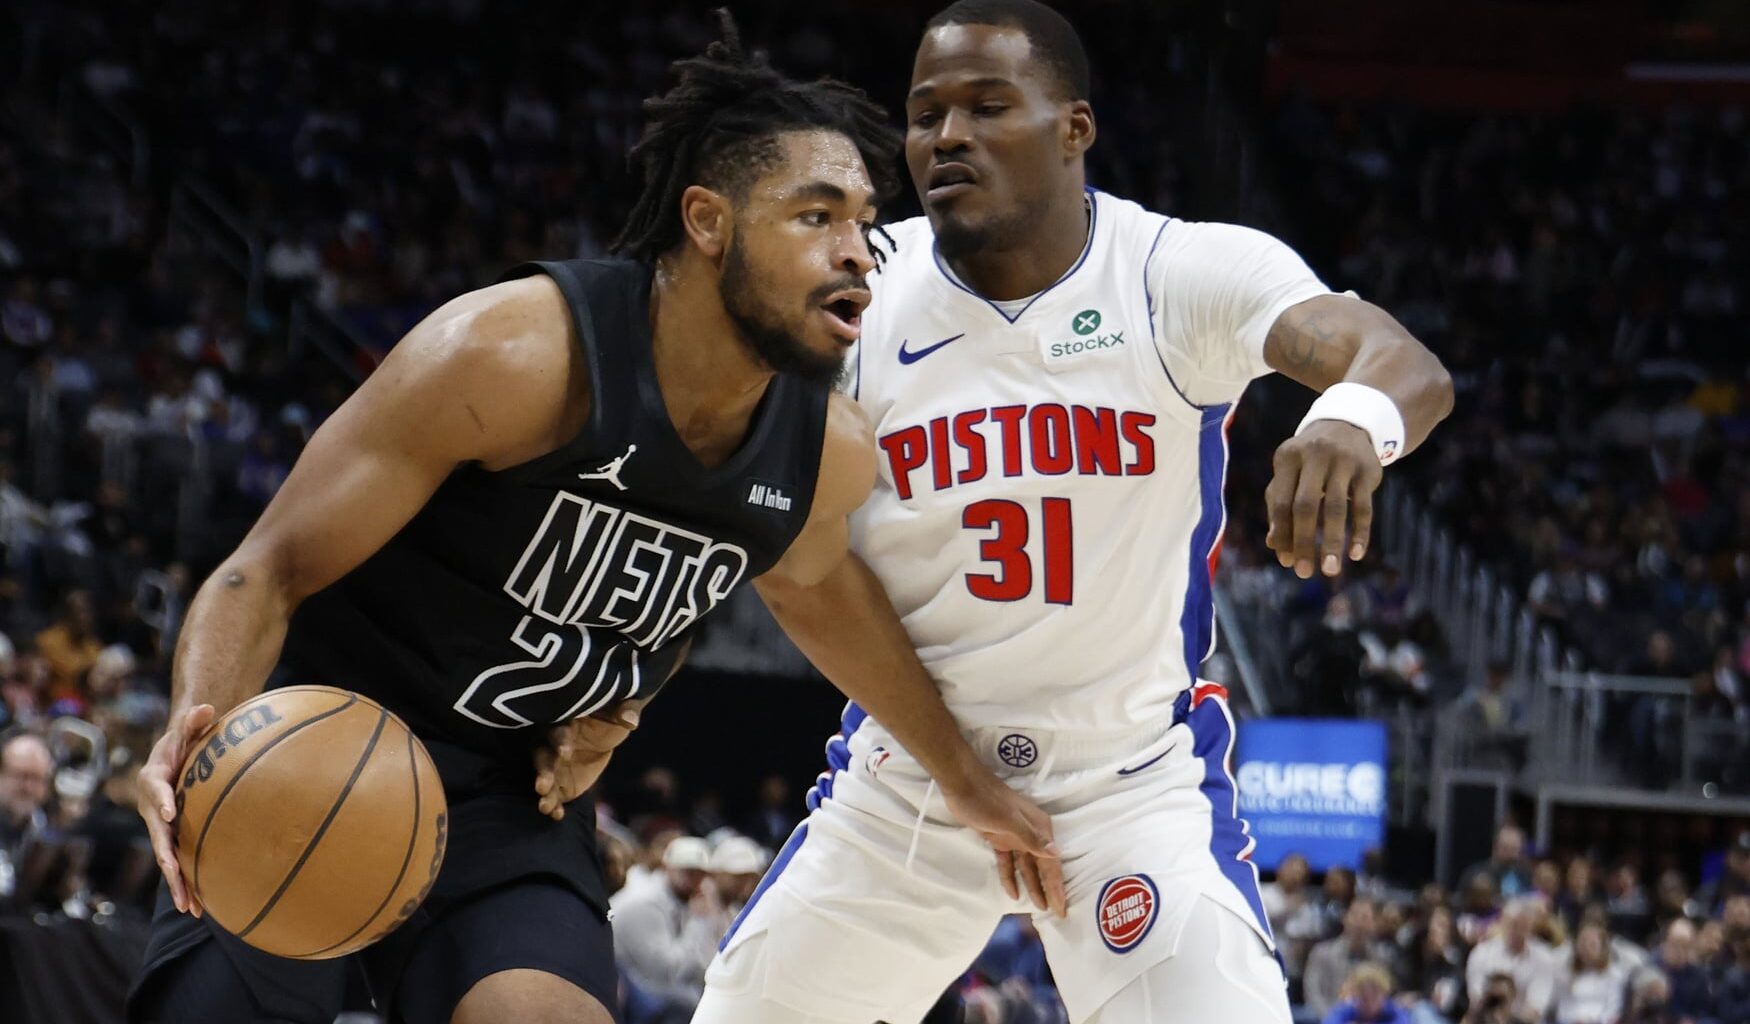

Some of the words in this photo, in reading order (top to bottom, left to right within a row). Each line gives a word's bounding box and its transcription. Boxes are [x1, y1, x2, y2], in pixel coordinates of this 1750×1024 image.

[1050, 330, 1125, 357] StockX
[879, 403, 1156, 500] PISTONS
[503, 490, 748, 652] NETS
[962, 497, 1073, 606] 31
[1106, 891, 1144, 919] DETROIT
[1108, 904, 1147, 932] PISTONS
